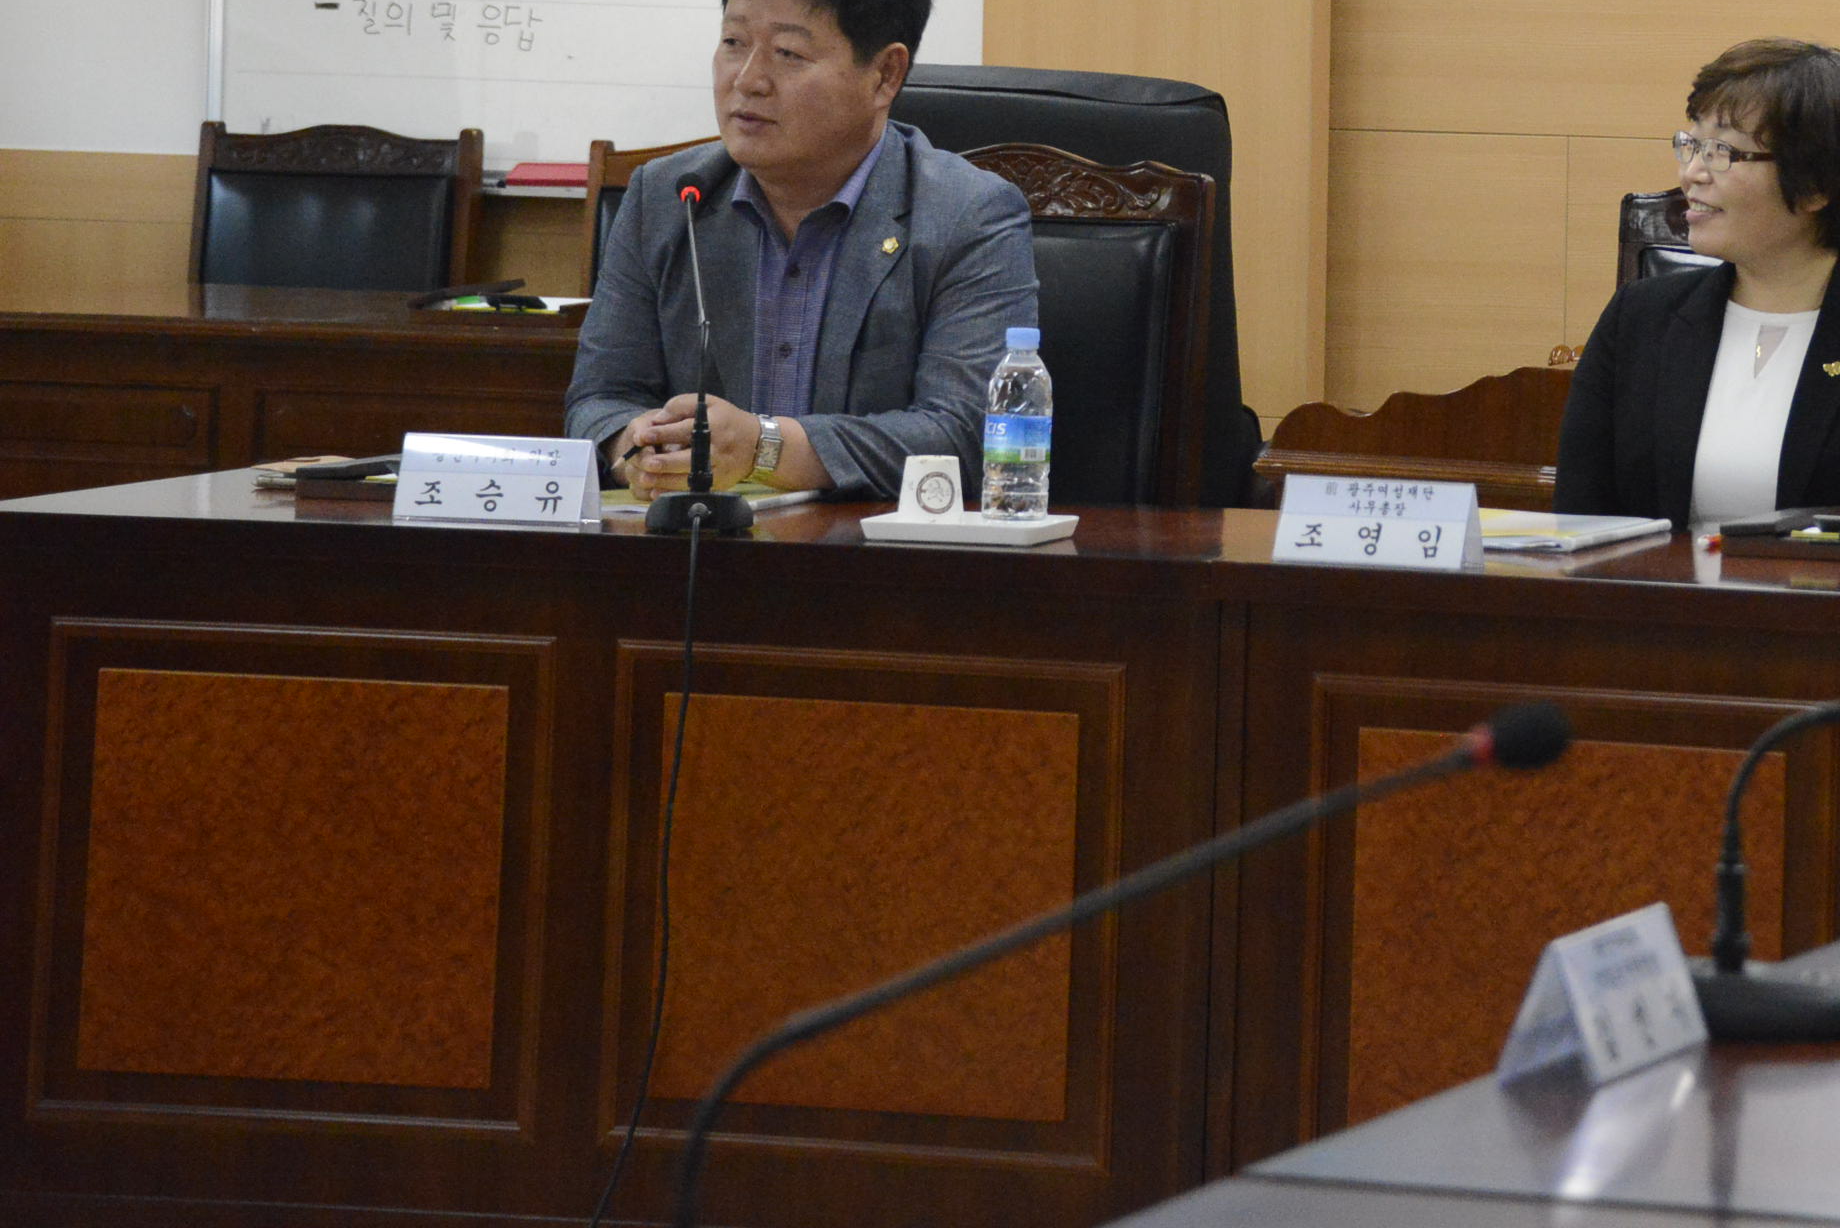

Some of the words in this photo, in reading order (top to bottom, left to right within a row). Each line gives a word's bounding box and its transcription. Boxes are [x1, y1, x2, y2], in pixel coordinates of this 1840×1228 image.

[430, 1, 457, 41] 및
[477, 4, 543, 52] 응답
[414, 478, 563, 514] 조승유
[1294, 522, 1443, 559] 조영임
